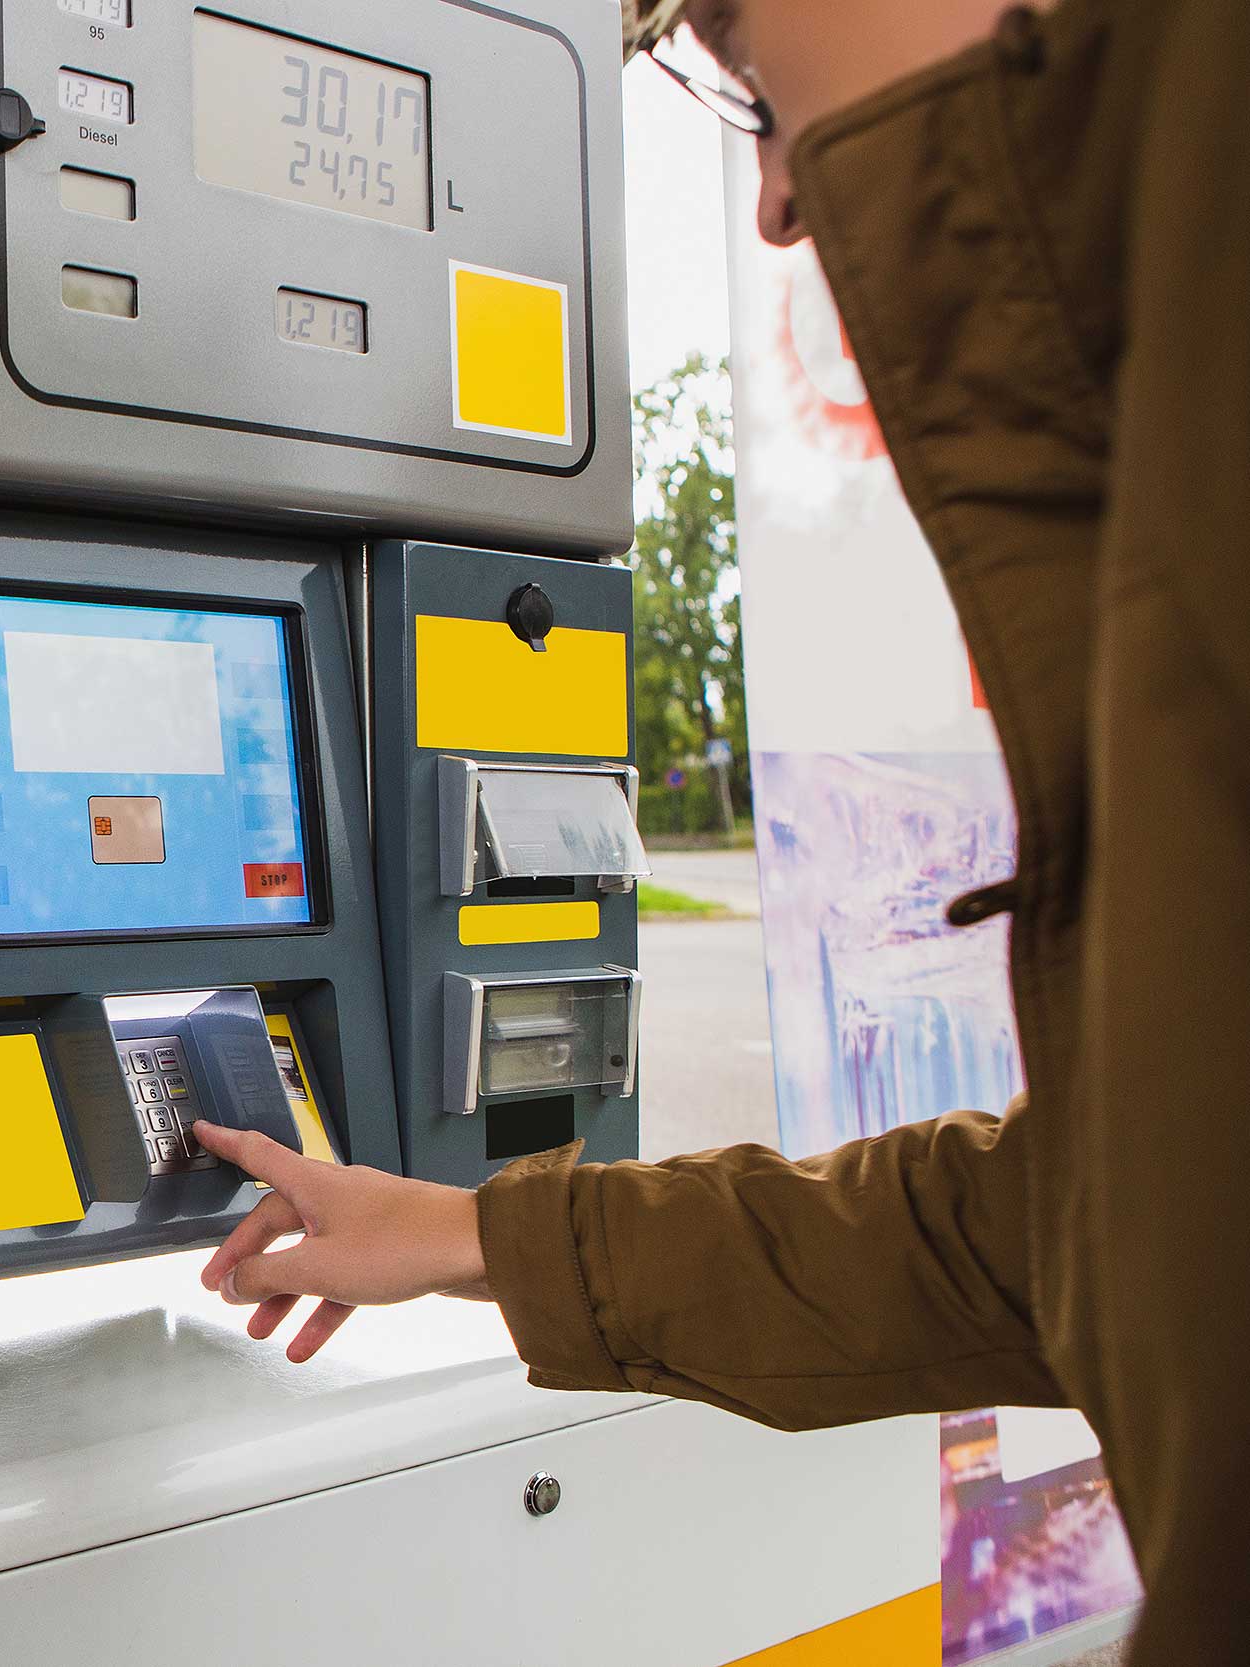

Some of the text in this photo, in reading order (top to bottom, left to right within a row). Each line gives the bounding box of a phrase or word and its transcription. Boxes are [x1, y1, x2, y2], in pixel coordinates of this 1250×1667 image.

[89, 25, 105, 40] 95
[65, 79, 123, 116] 1,219
[281, 55, 422, 156] 30,17
[79, 126, 118, 146] Diesel
[289, 140, 396, 207] 24,75
[447, 179, 464, 213] L
[286, 299, 359, 346] 1,219
[261, 874, 287, 886] STOP
[157, 1049, 175, 1057] CANCEL
[140, 1060, 148, 1070] 3
[150, 1089, 157, 1099] 6
[158, 1118, 166, 1128] 9
